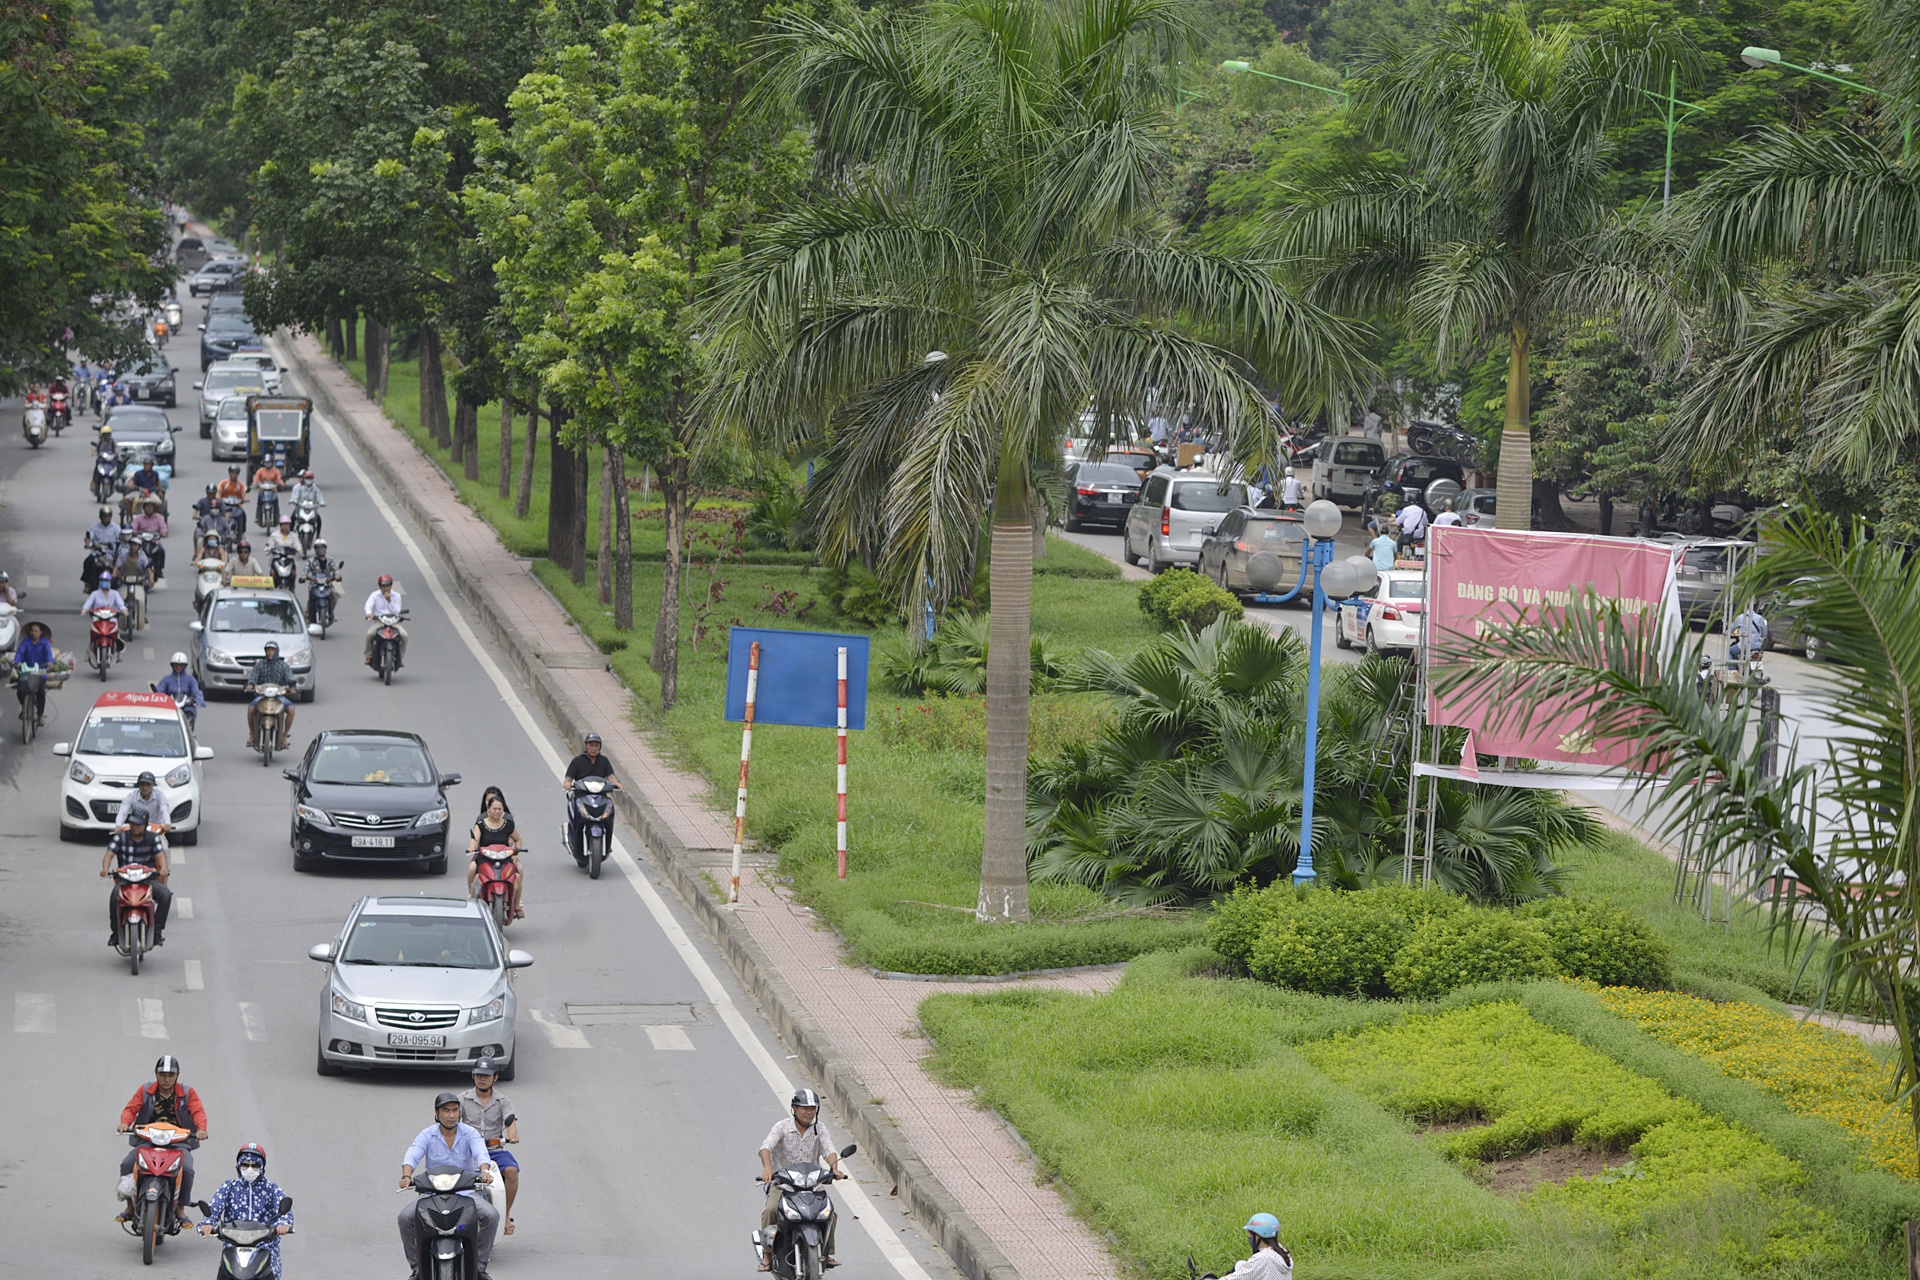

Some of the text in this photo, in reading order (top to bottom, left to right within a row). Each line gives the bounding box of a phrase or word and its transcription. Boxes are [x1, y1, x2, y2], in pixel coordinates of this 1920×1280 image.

[1457, 580, 1494, 602] ĐẢNG
[1522, 586, 1541, 605] VÀ
[123, 693, 168, 704] Alpha taxi
[391, 1034, 442, 1047] 29A-095.94
